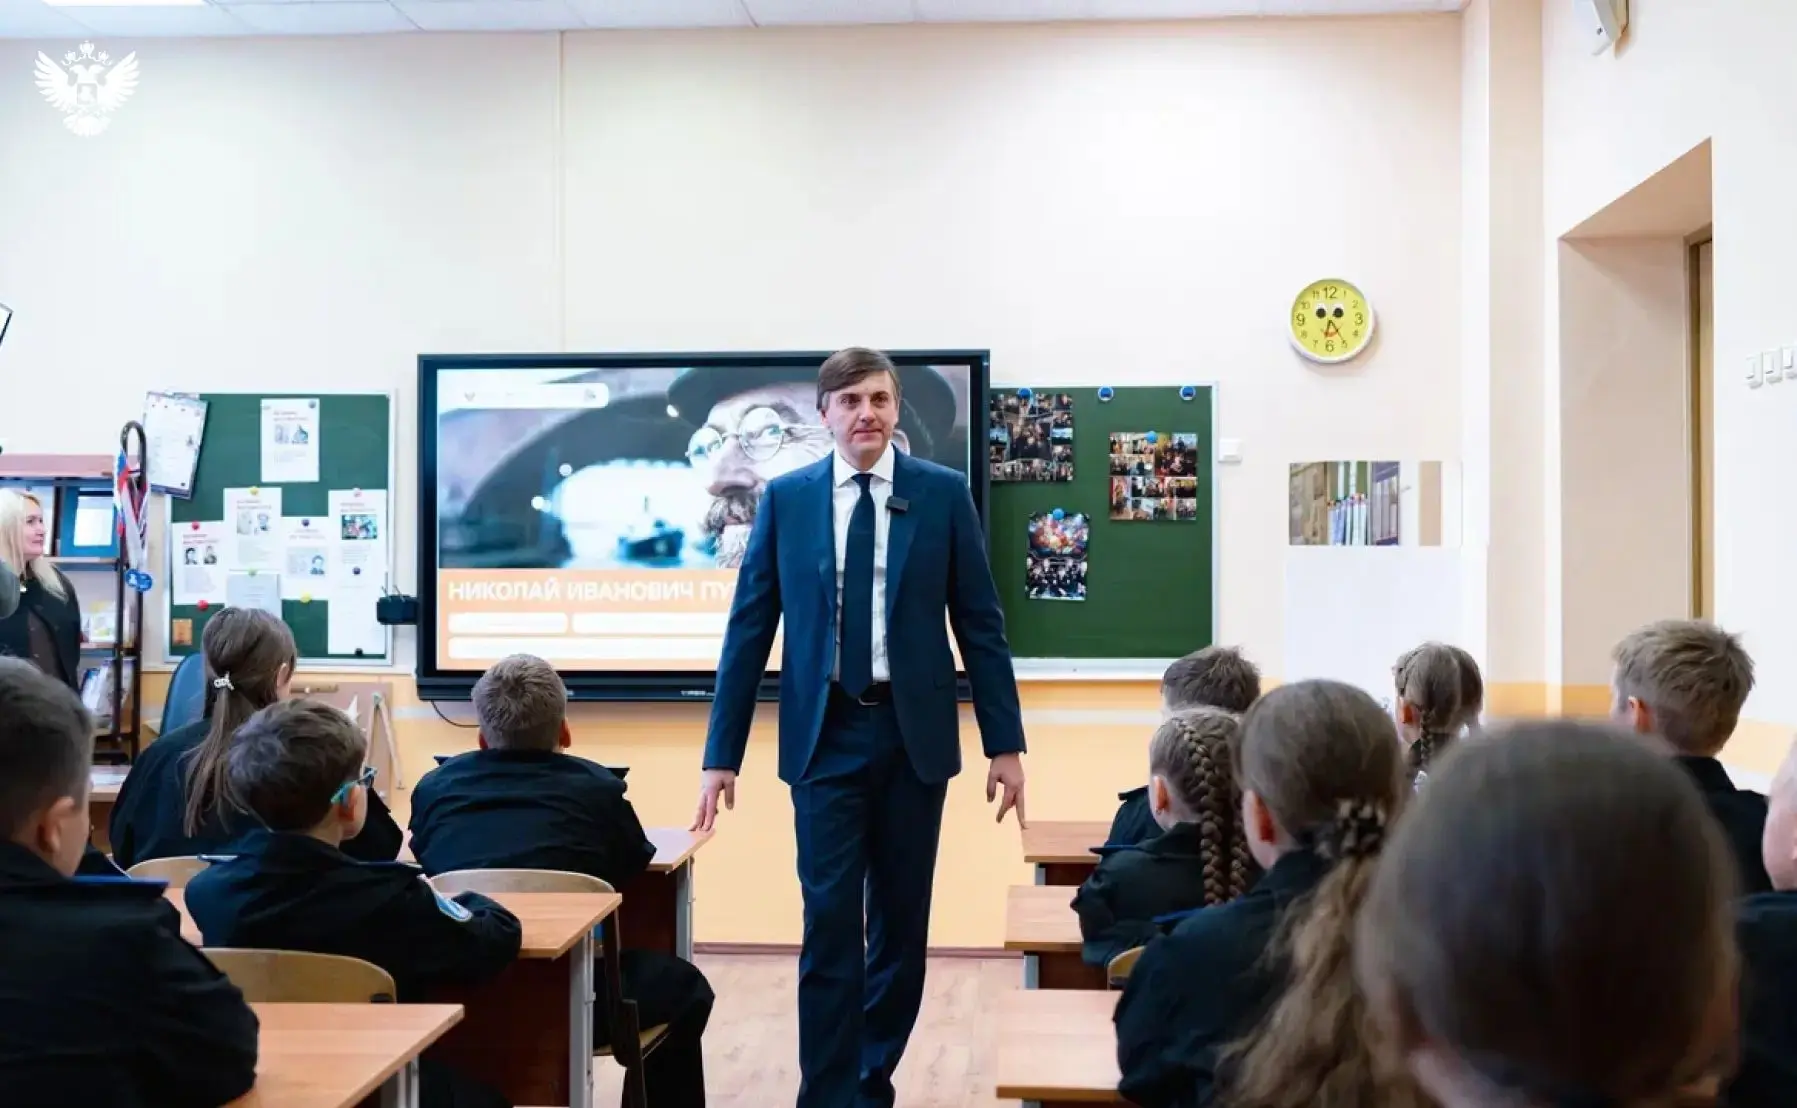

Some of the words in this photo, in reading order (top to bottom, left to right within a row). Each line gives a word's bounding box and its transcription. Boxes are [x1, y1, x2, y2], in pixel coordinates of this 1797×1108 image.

[1323, 285, 1337, 299] 12
[1295, 312, 1305, 327] 9
[1354, 312, 1364, 326] 3
[1325, 339, 1335, 353] 6
[448, 576, 561, 602] НИКОЛАЙ
[567, 581, 694, 602] ИВАНОВИЧ
